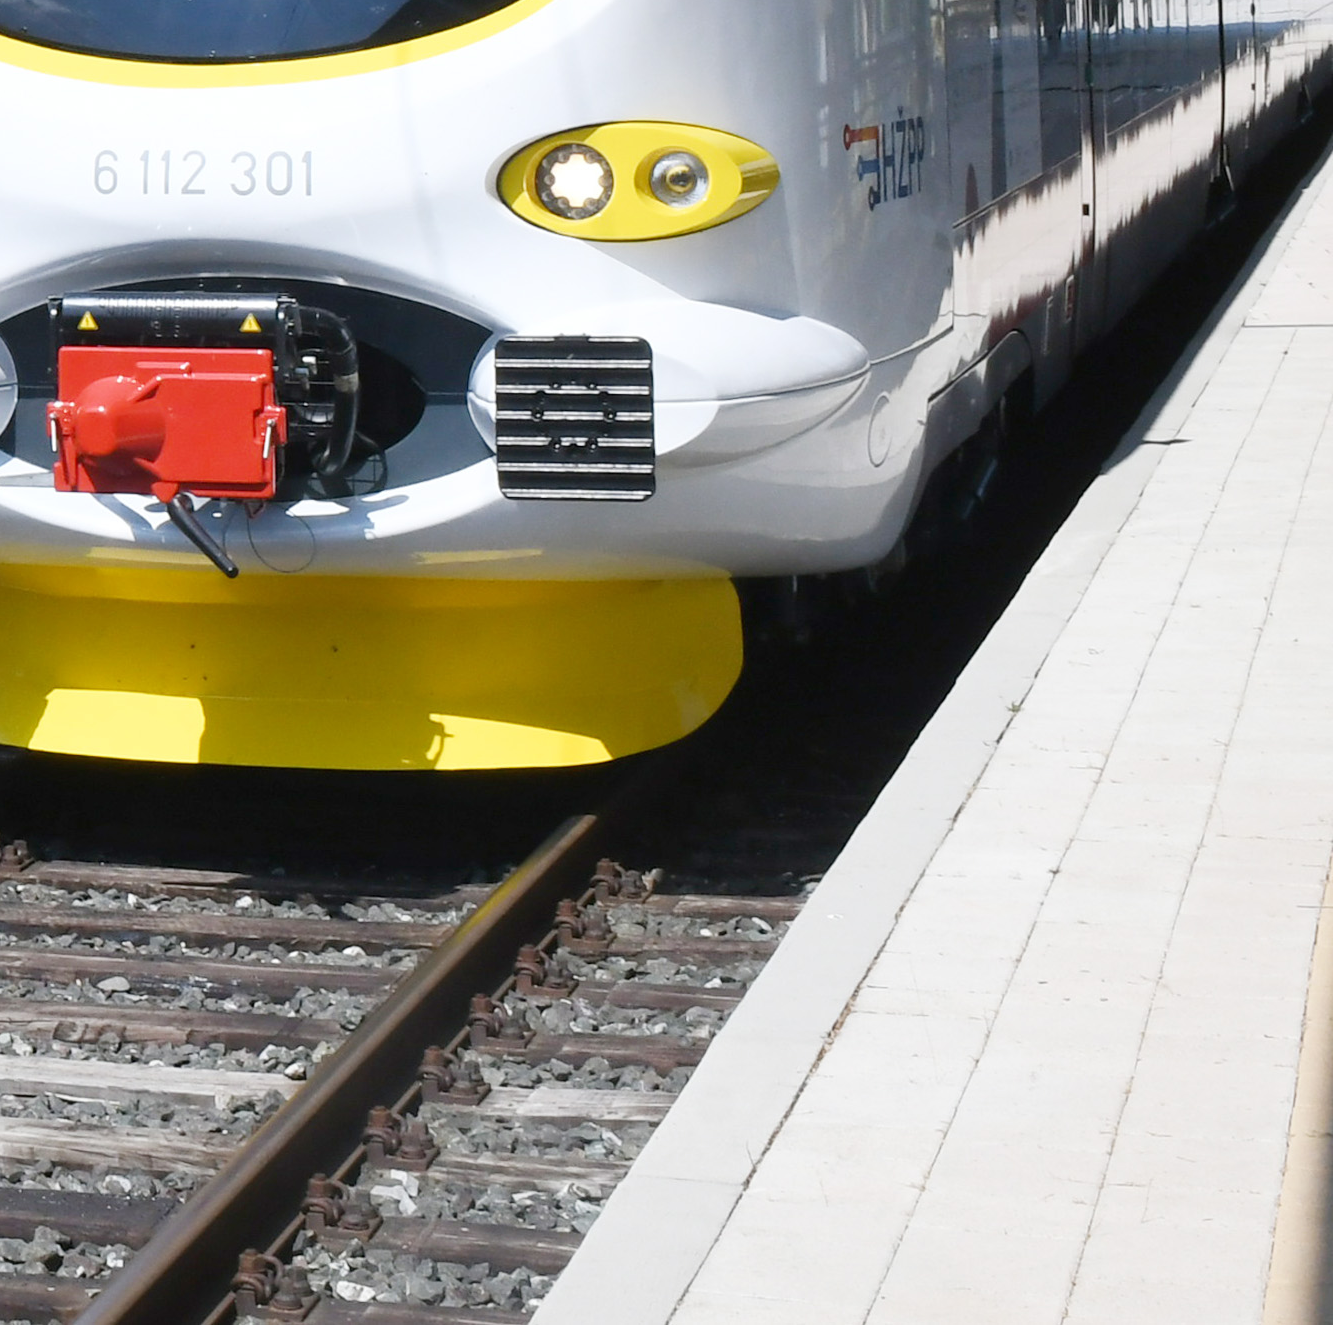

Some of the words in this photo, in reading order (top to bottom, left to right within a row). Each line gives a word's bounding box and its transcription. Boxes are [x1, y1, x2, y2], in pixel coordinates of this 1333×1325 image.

[94, 150, 118, 195] 6
[140, 150, 206, 195] 112
[230, 151, 312, 196] 301
[882, 106, 925, 202] HŽPP
